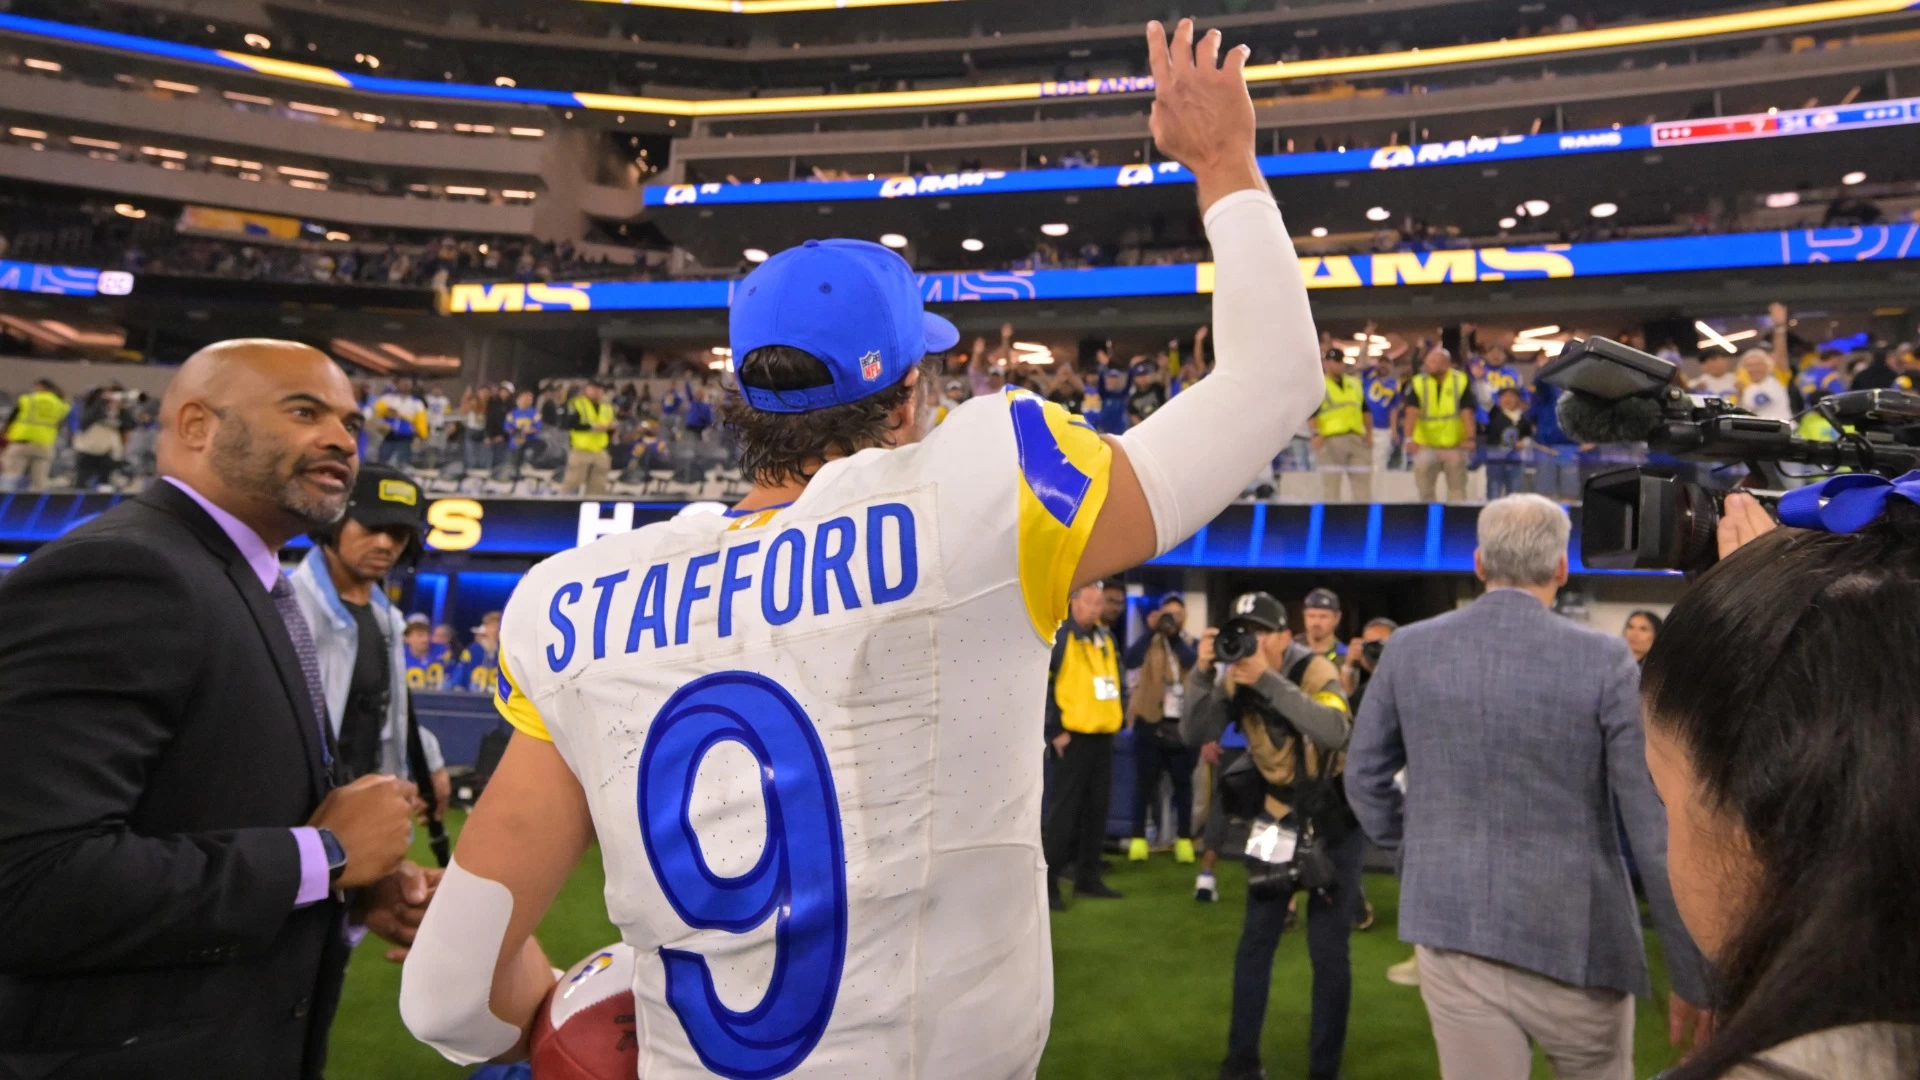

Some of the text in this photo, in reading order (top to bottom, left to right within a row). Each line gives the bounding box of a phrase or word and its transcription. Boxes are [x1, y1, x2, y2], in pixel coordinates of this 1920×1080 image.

[1197, 244, 1573, 293] AMS
[546, 502, 918, 673] STAFFORD
[637, 670, 848, 1080] 9
